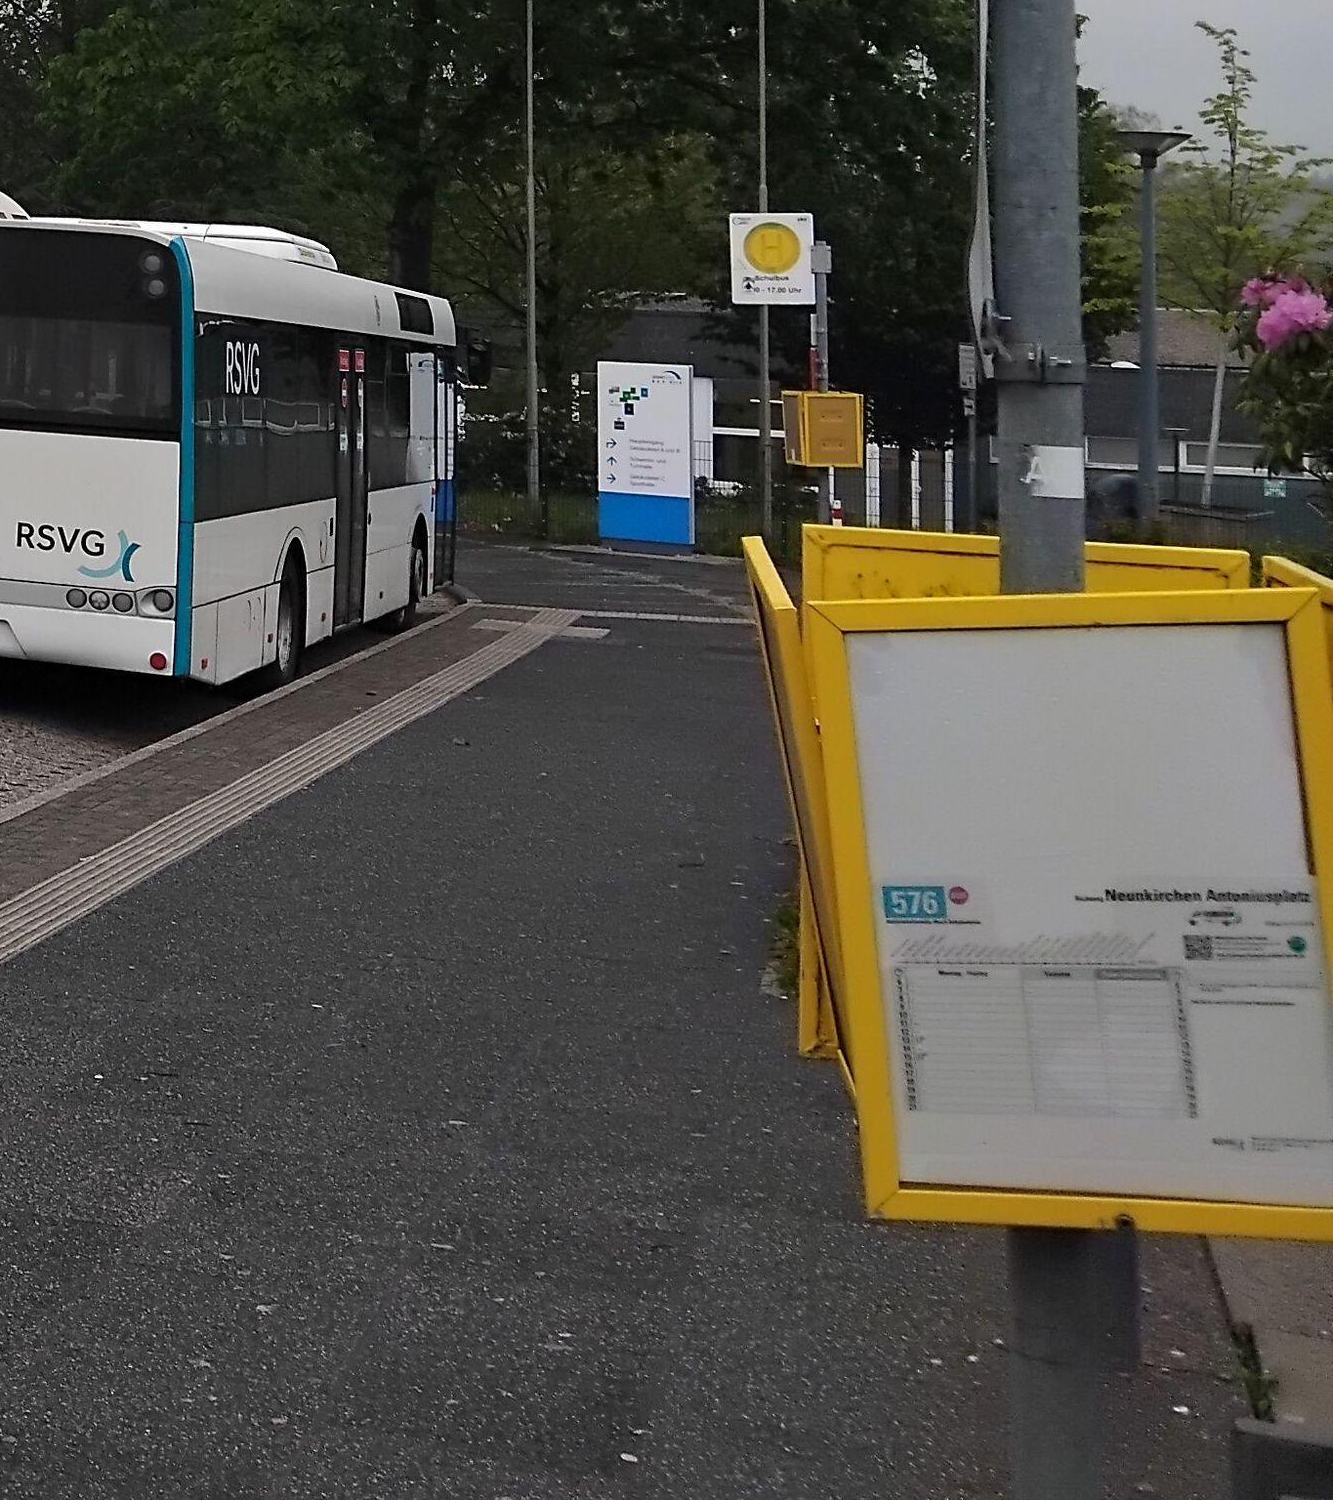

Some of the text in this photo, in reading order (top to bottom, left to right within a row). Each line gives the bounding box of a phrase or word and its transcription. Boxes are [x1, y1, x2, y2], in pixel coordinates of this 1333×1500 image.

[226, 341, 260, 395] RSVG
[16, 522, 105, 557] RSVG
[891, 891, 939, 915] 576
[1104, 888, 1202, 902] Neunkirchen
